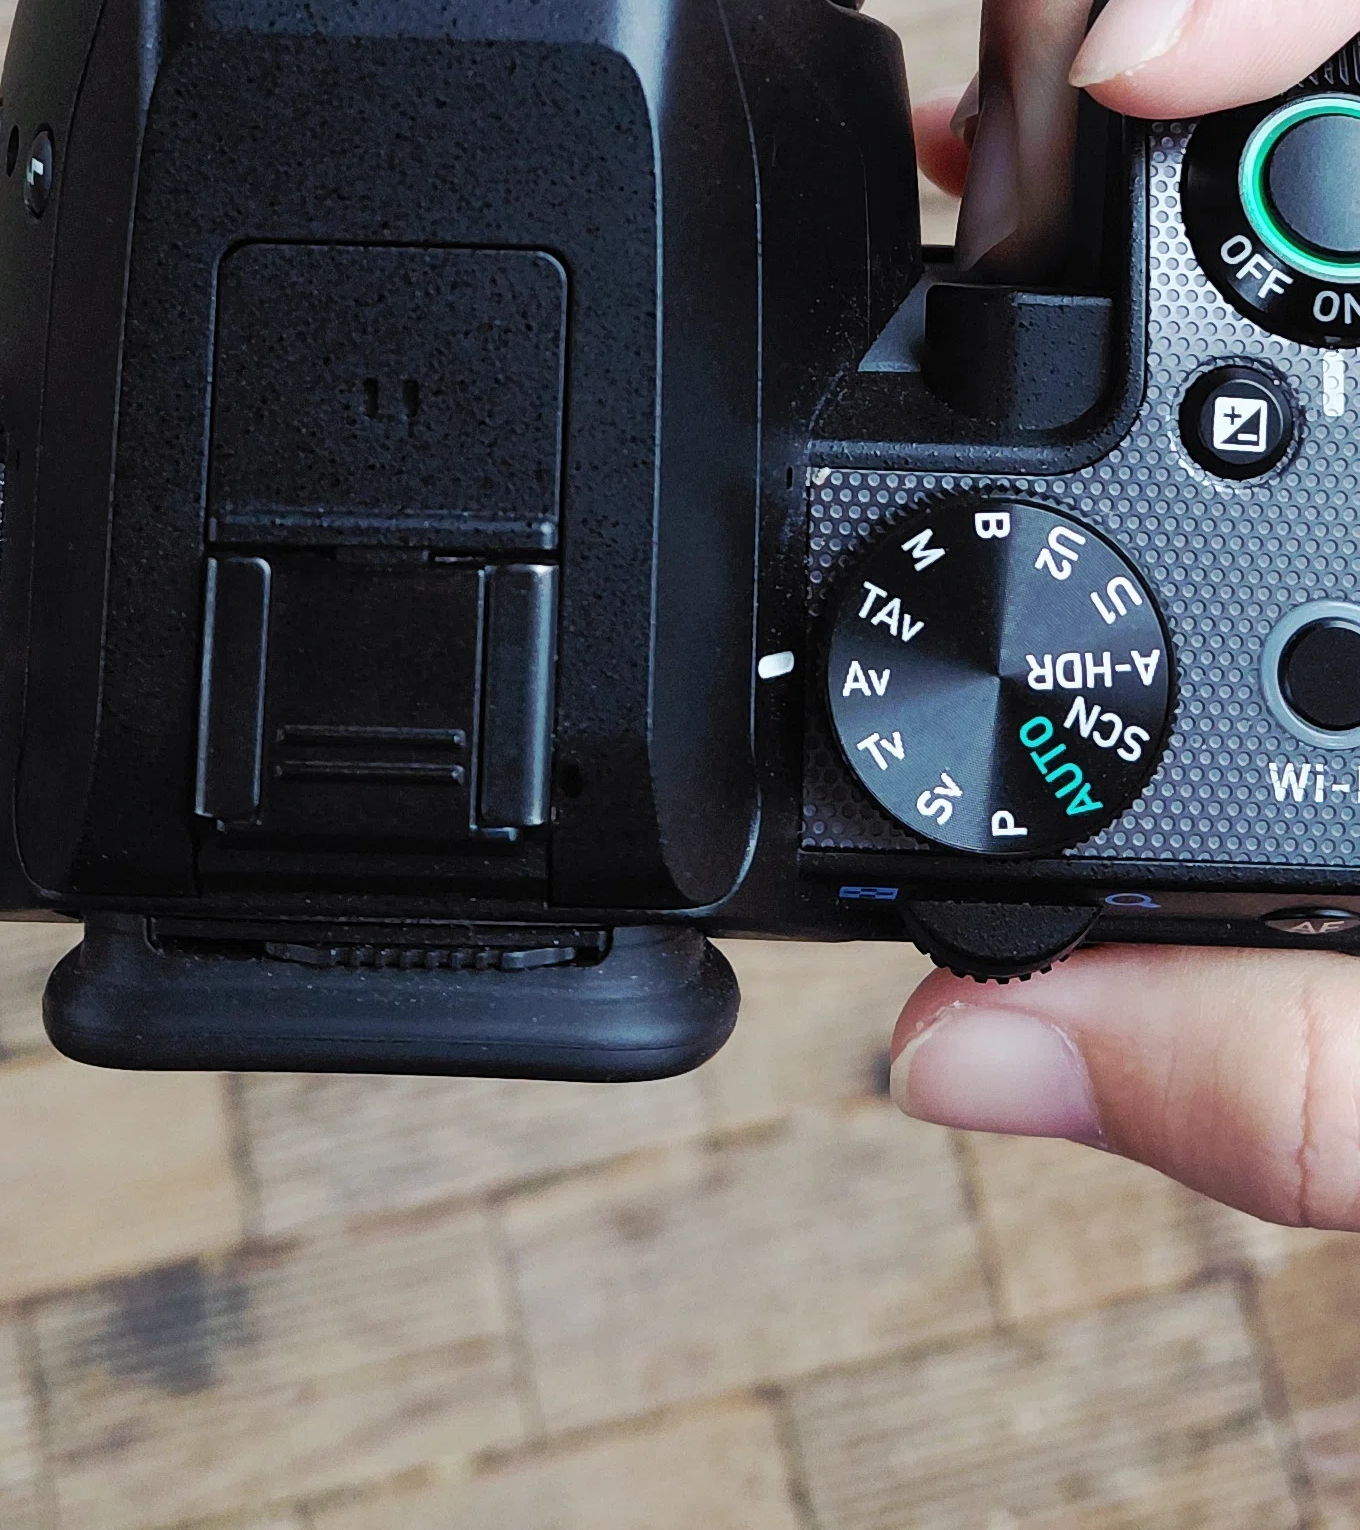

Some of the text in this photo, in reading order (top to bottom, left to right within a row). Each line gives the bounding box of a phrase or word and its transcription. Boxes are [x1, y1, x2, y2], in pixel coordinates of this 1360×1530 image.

[1220, 234, 1294, 299] OFF
[974, 511, 1011, 539] B
[901, 528, 946, 572] M
[1034, 525, 1086, 581] U2
[857, 580, 925, 642] TAv
[1090, 576, 1142, 624] U1
[842, 660, 891, 696] Av
[1025, 649, 1161, 690] A-HDR
[856, 731, 905, 771] Tv
[1063, 695, 1151, 762] SCN
[1019, 715, 1104, 817] AUTO
[916, 772, 963, 825] Sv
[991, 810, 1028, 837] P
